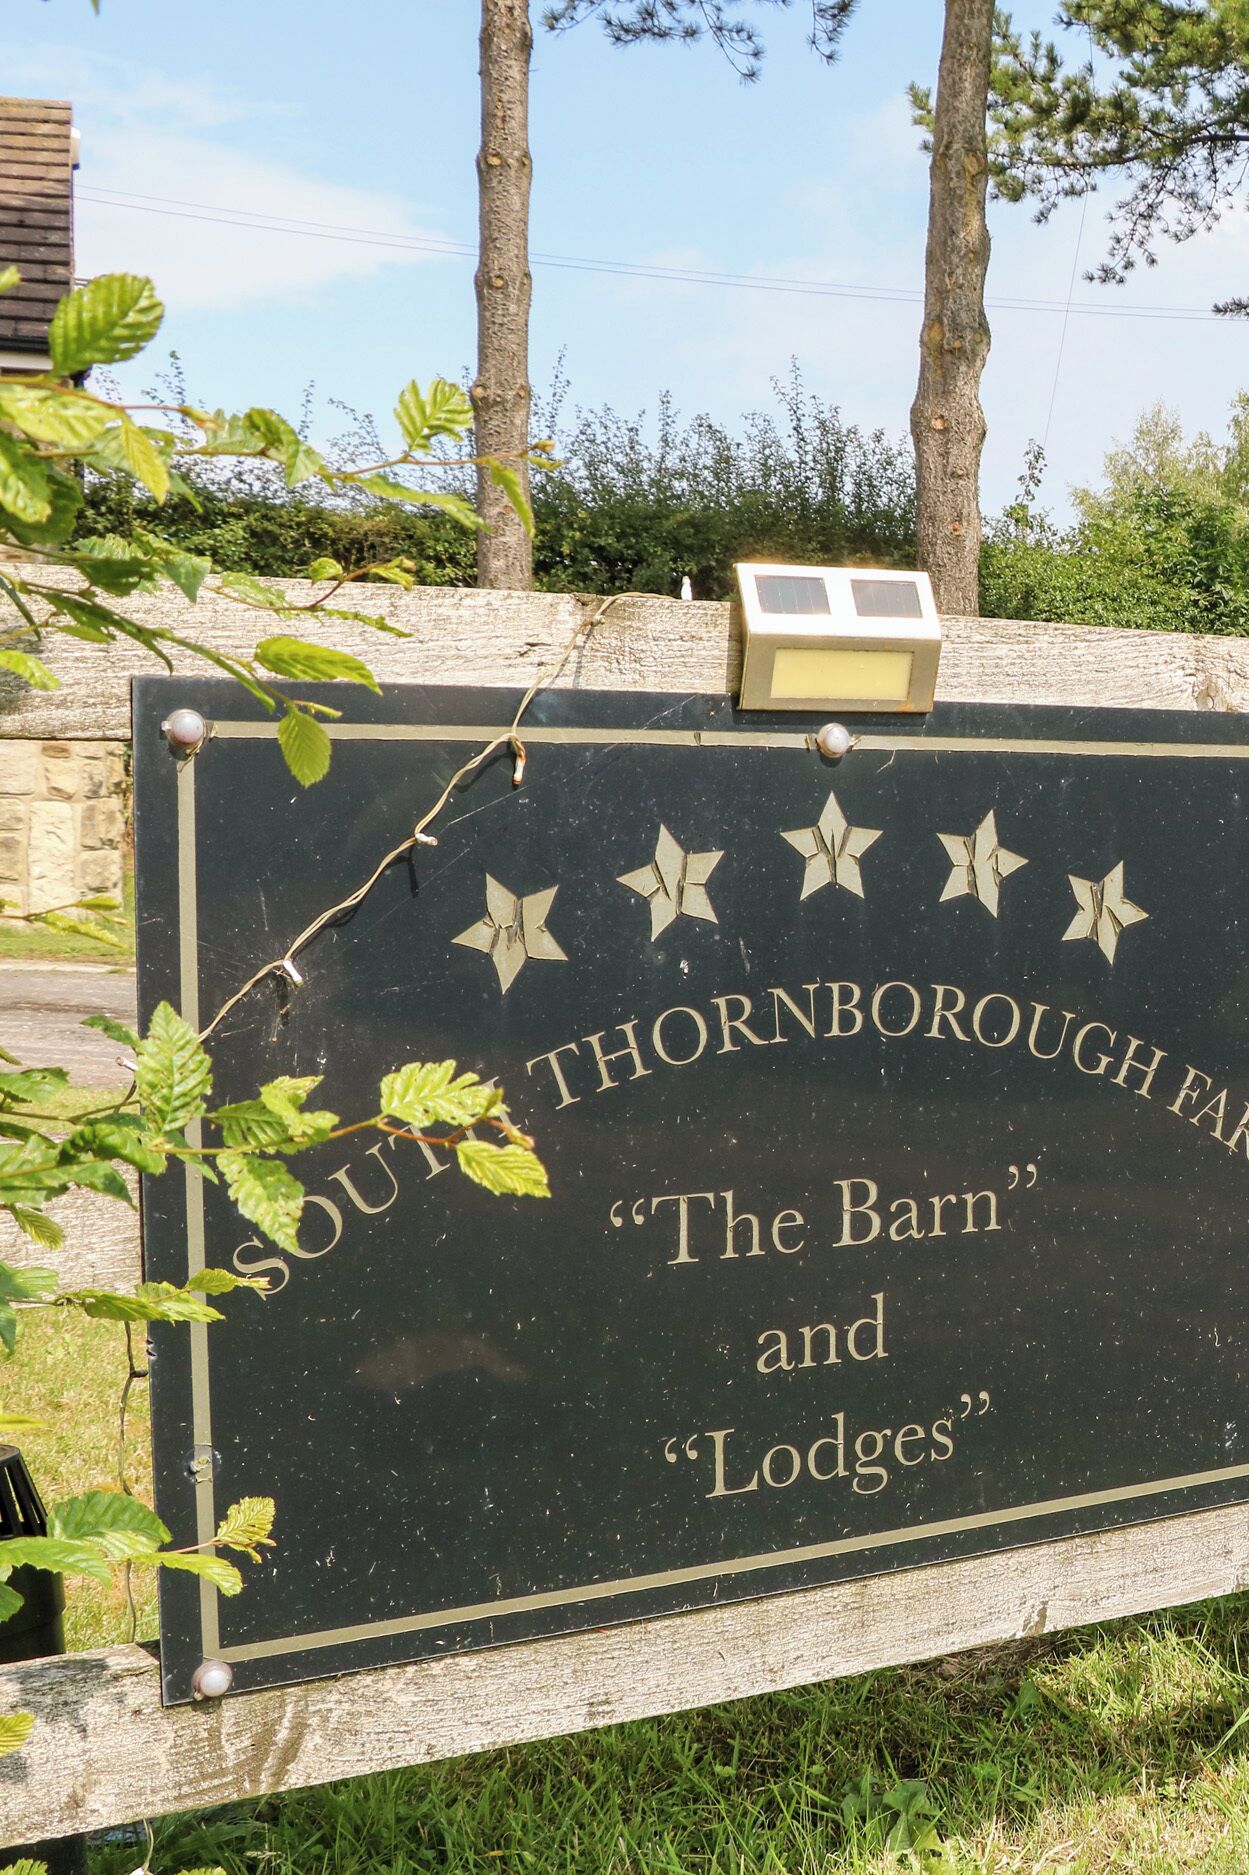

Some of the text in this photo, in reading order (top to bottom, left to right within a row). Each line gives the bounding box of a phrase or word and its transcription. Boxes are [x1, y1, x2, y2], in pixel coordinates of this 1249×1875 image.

[527, 979, 1168, 1110] THORNBOROUGH
[610, 1163, 1038, 1265] “The Barn”
[756, 1292, 889, 1374] and
[664, 1391, 991, 1499] “Lodges”
